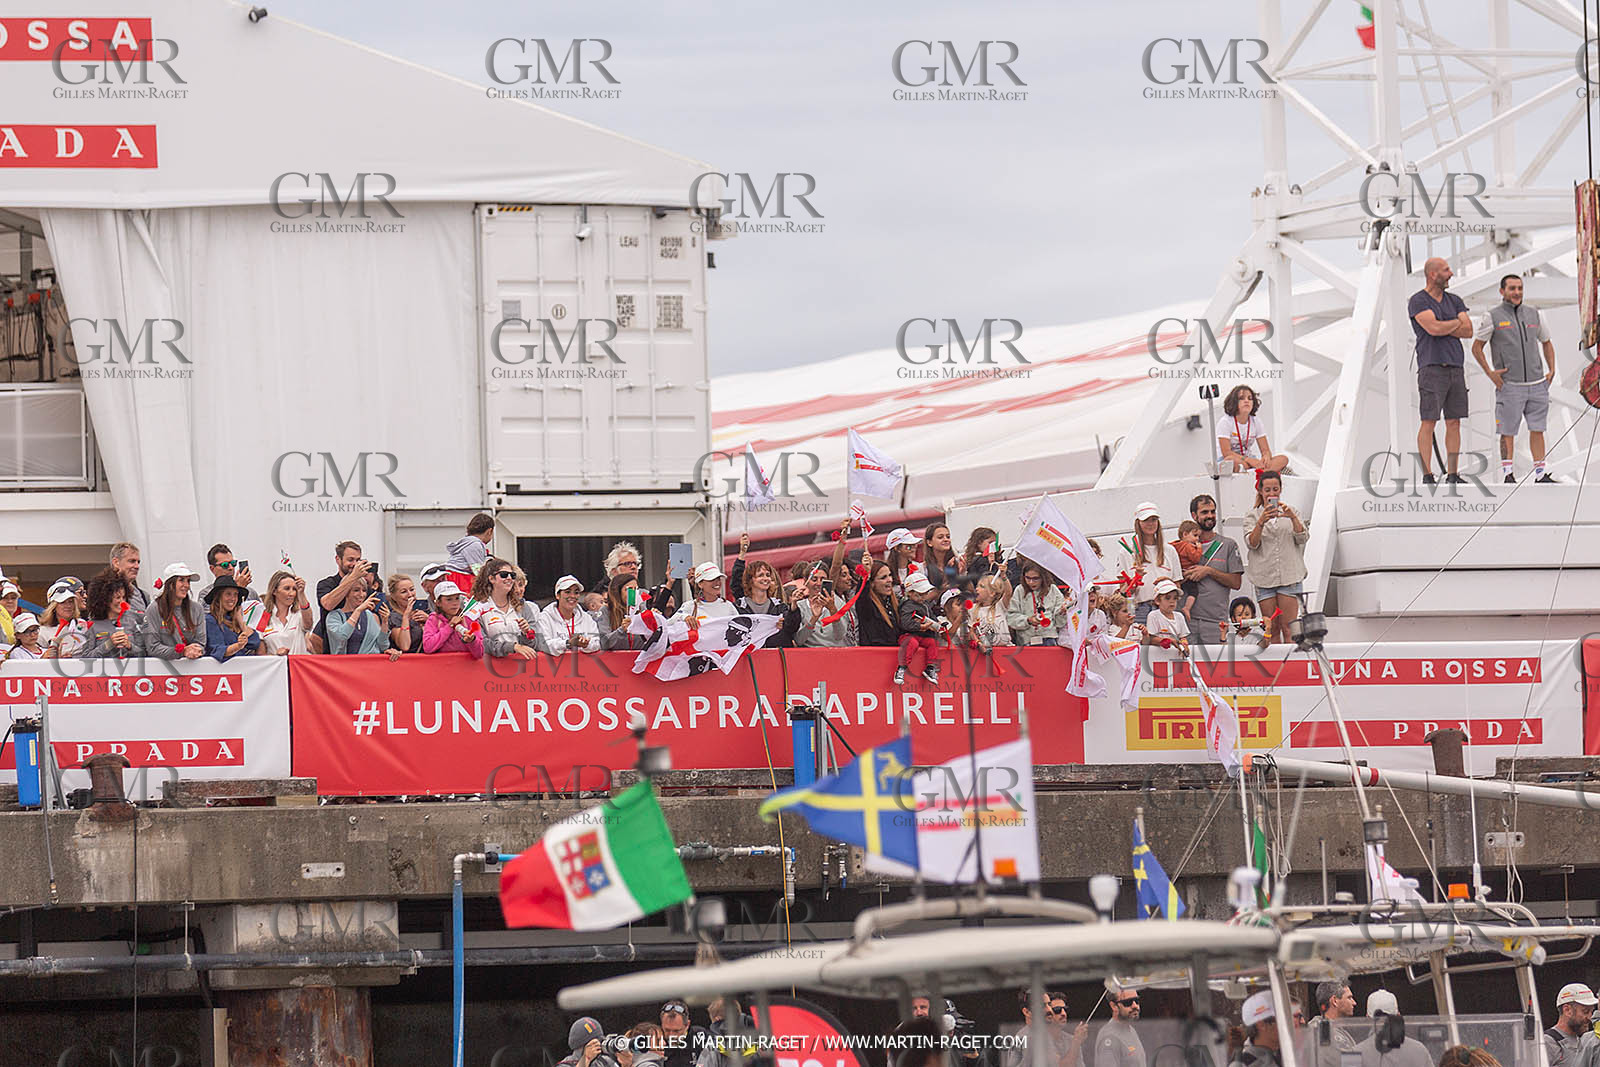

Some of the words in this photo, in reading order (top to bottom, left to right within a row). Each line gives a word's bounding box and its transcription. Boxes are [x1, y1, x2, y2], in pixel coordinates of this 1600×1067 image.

[0, 20, 139, 51] SSA
[1307, 660, 1398, 680] LUNA
[1421, 659, 1533, 679] ROSSA
[108, 676, 234, 698] ROSSA
